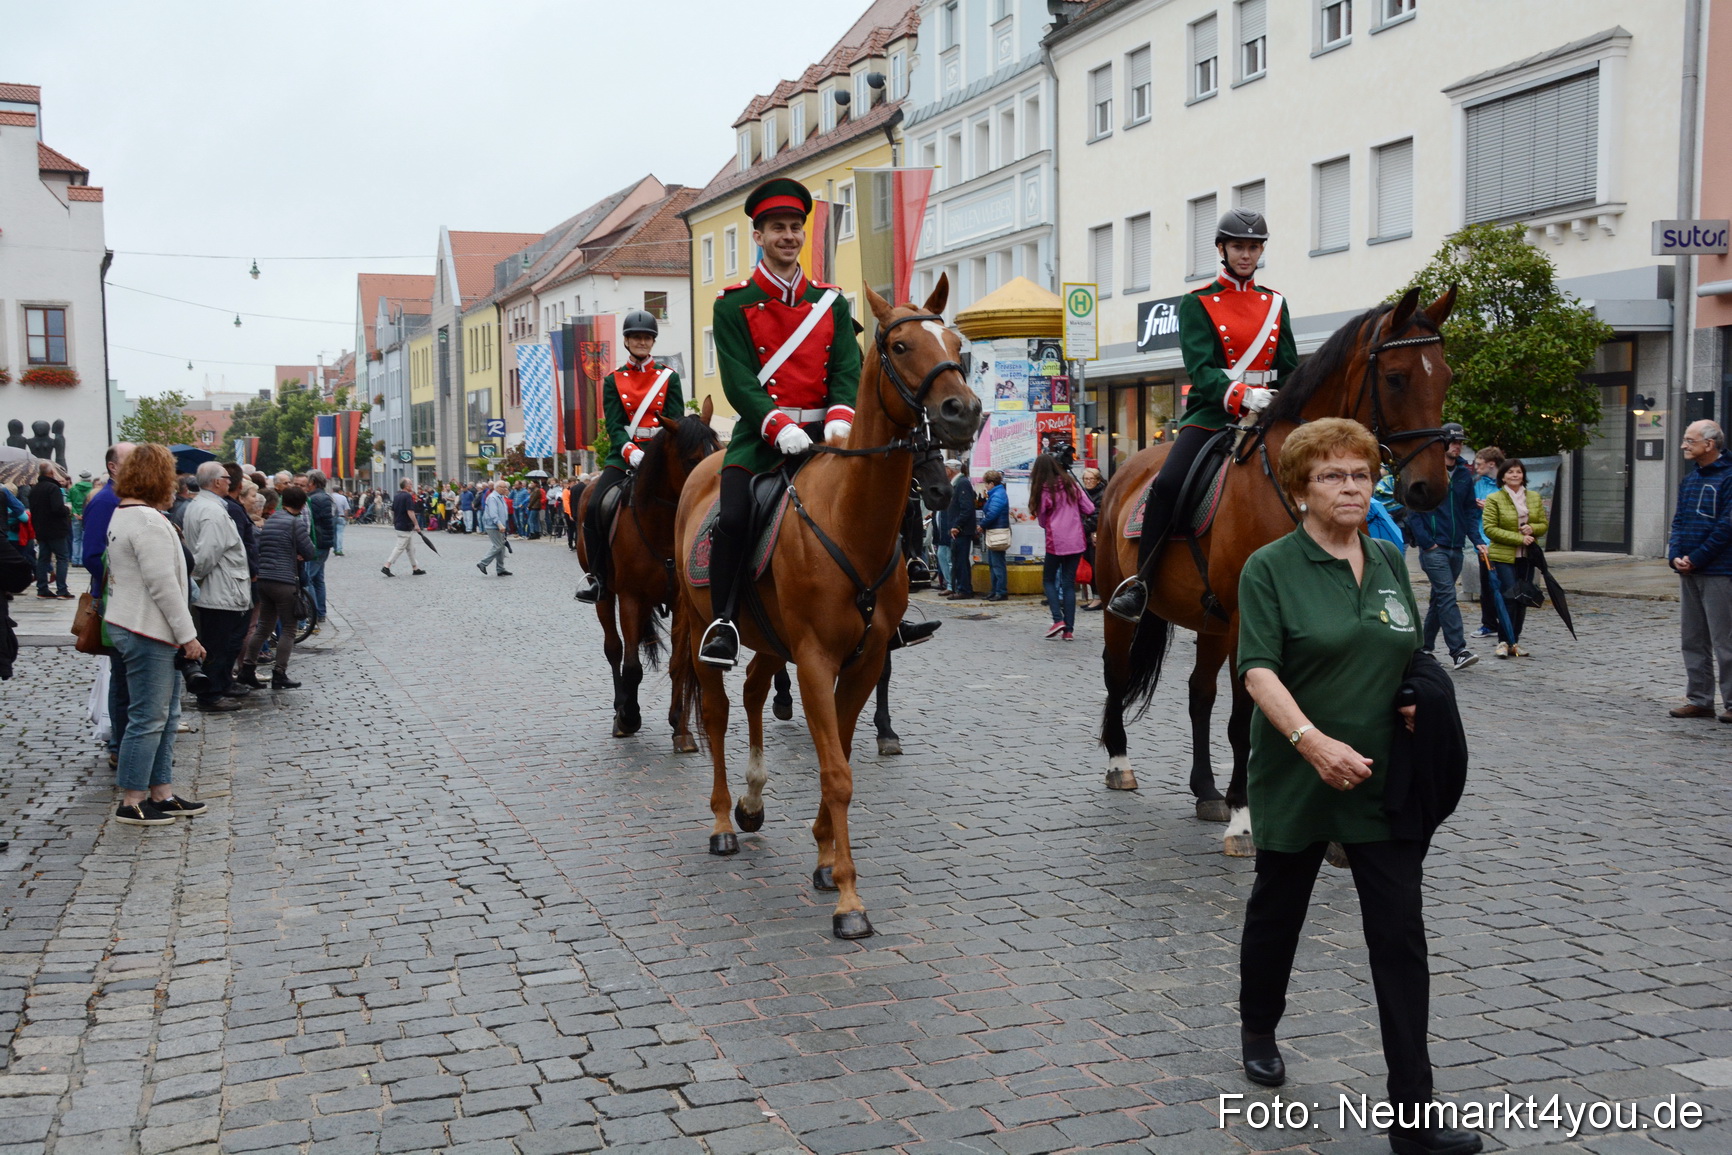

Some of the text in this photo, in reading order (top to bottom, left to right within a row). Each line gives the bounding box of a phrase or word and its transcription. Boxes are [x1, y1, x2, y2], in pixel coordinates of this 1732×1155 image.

[949, 197, 1012, 234] BRILLEN WEBER
[1075, 295, 1087, 311] H
[1137, 302, 1180, 347] früh
